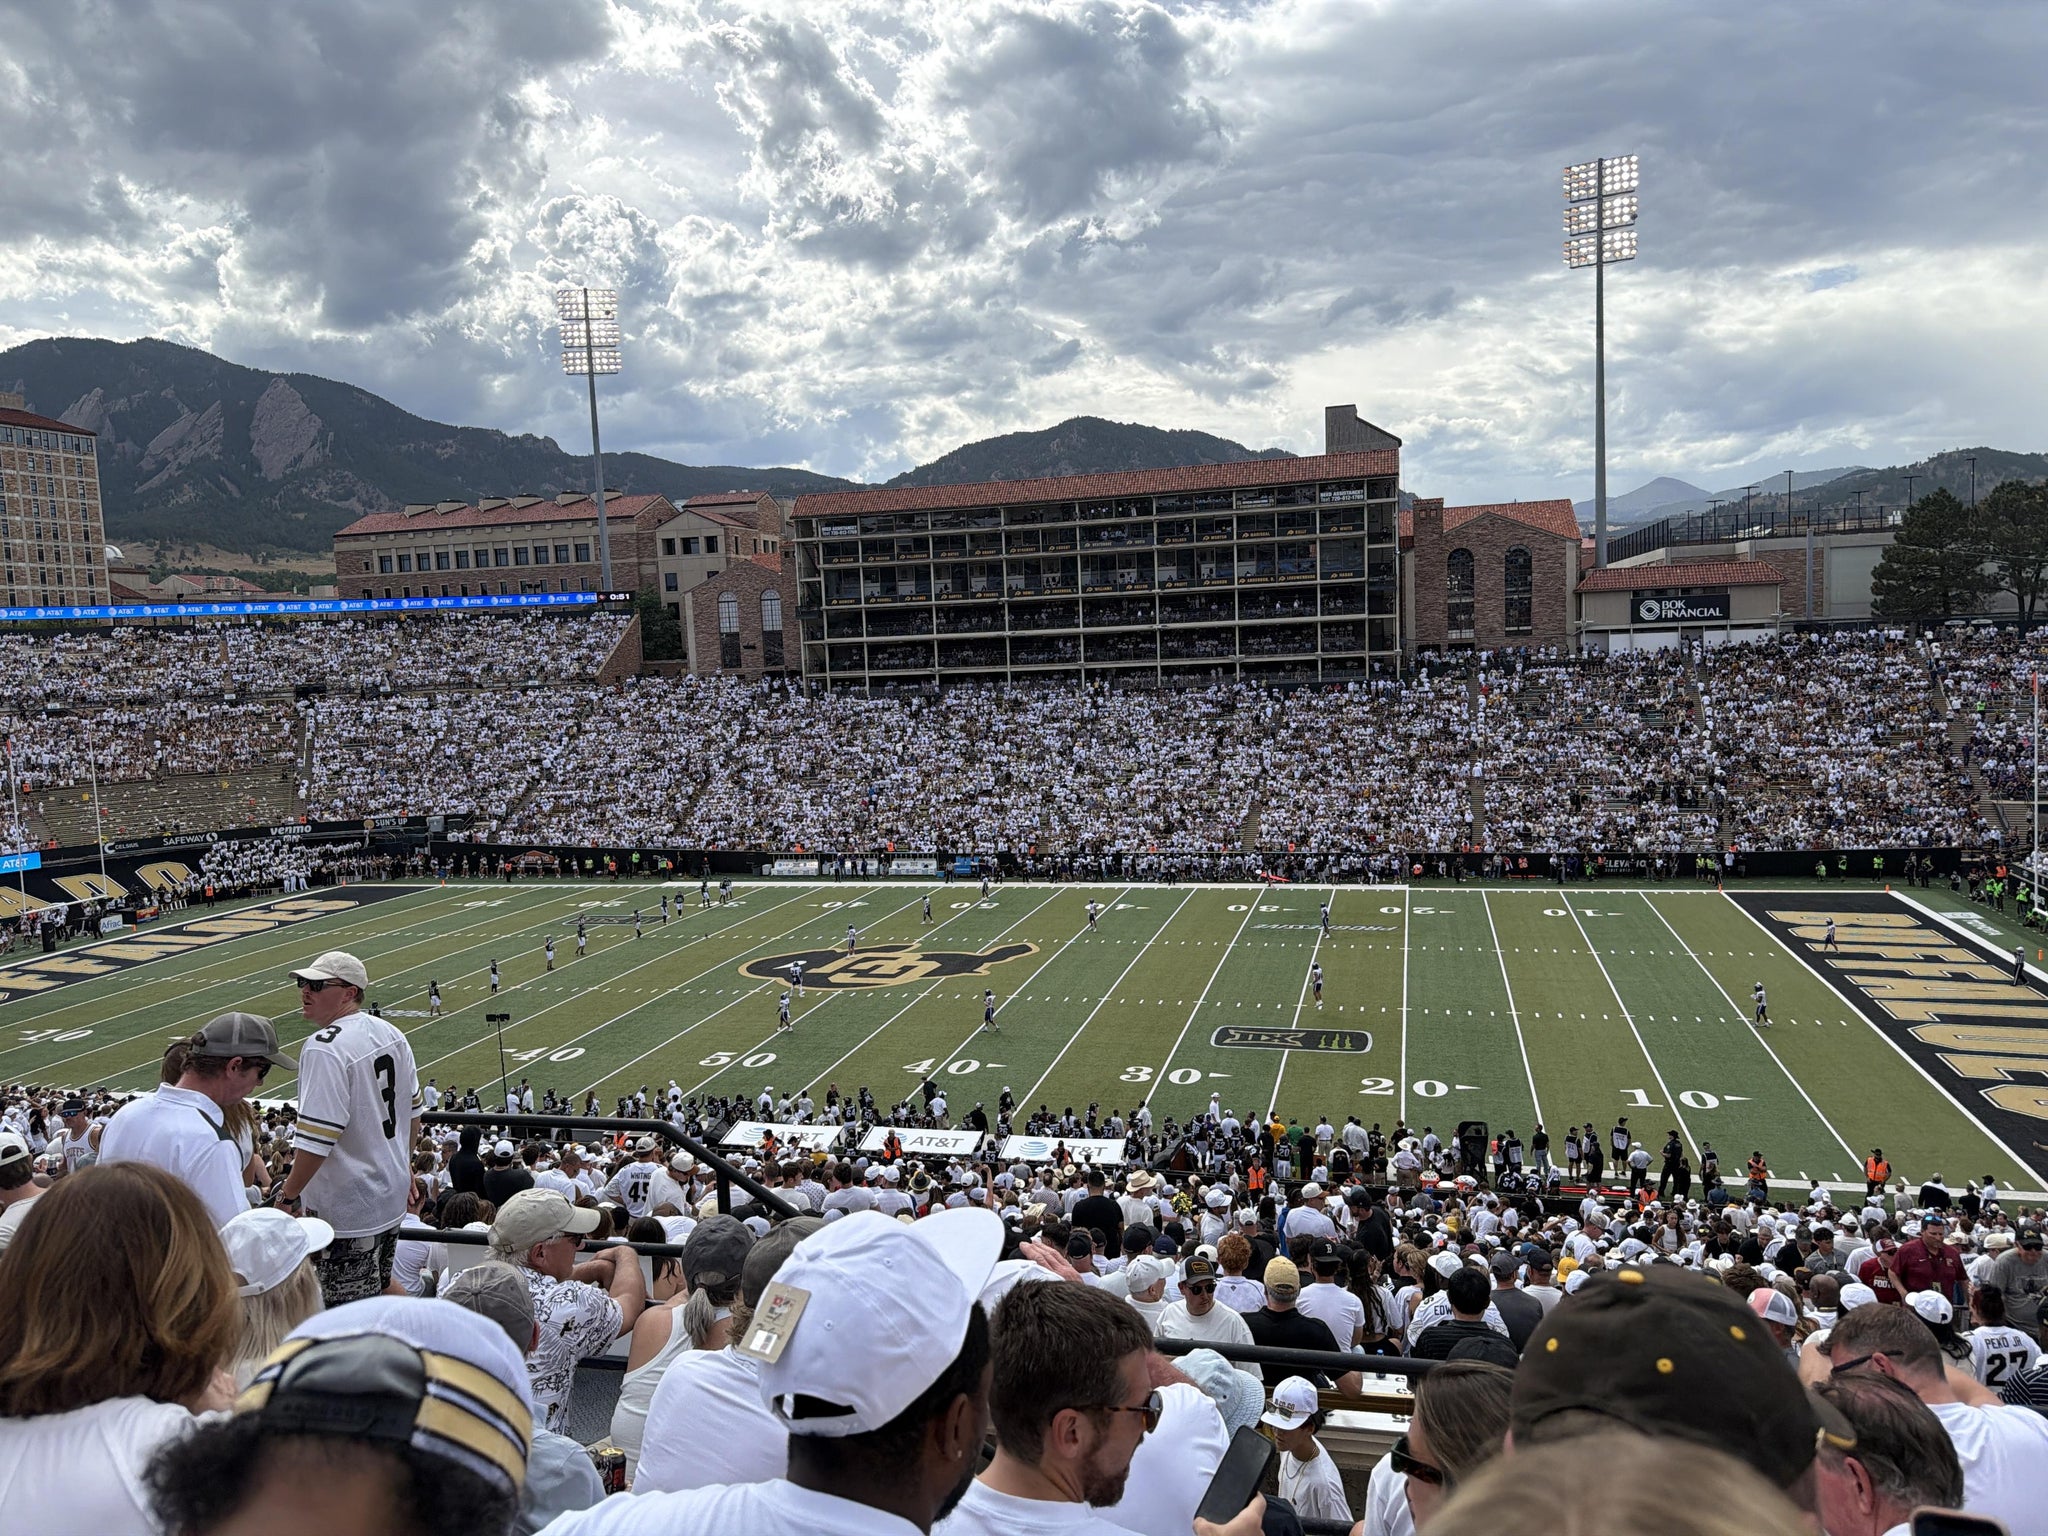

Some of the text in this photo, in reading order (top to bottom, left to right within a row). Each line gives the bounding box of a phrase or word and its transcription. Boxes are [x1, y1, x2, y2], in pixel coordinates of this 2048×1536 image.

[1662, 600, 1686, 610] BOK
[1662, 606, 1723, 619] FINANCIAL
[270, 824, 312, 836] venmo
[163, 834, 205, 847] SAFEWAY
[2, 857, 28, 869] AT&T
[315, 1024, 342, 1044] 3
[512, 1046, 586, 1062] 40
[698, 1052, 777, 1068] 50
[902, 1058, 980, 1076] 40
[1120, 1066, 1202, 1086] 30
[1360, 1076, 1448, 1098] 20
[374, 1053, 398, 1140] 3
[1620, 1088, 1720, 1110] 10
[909, 1136, 964, 1148] AT&T
[1984, 1336, 2022, 1350] PEKO JR
[1986, 1350, 2028, 1387] 27
